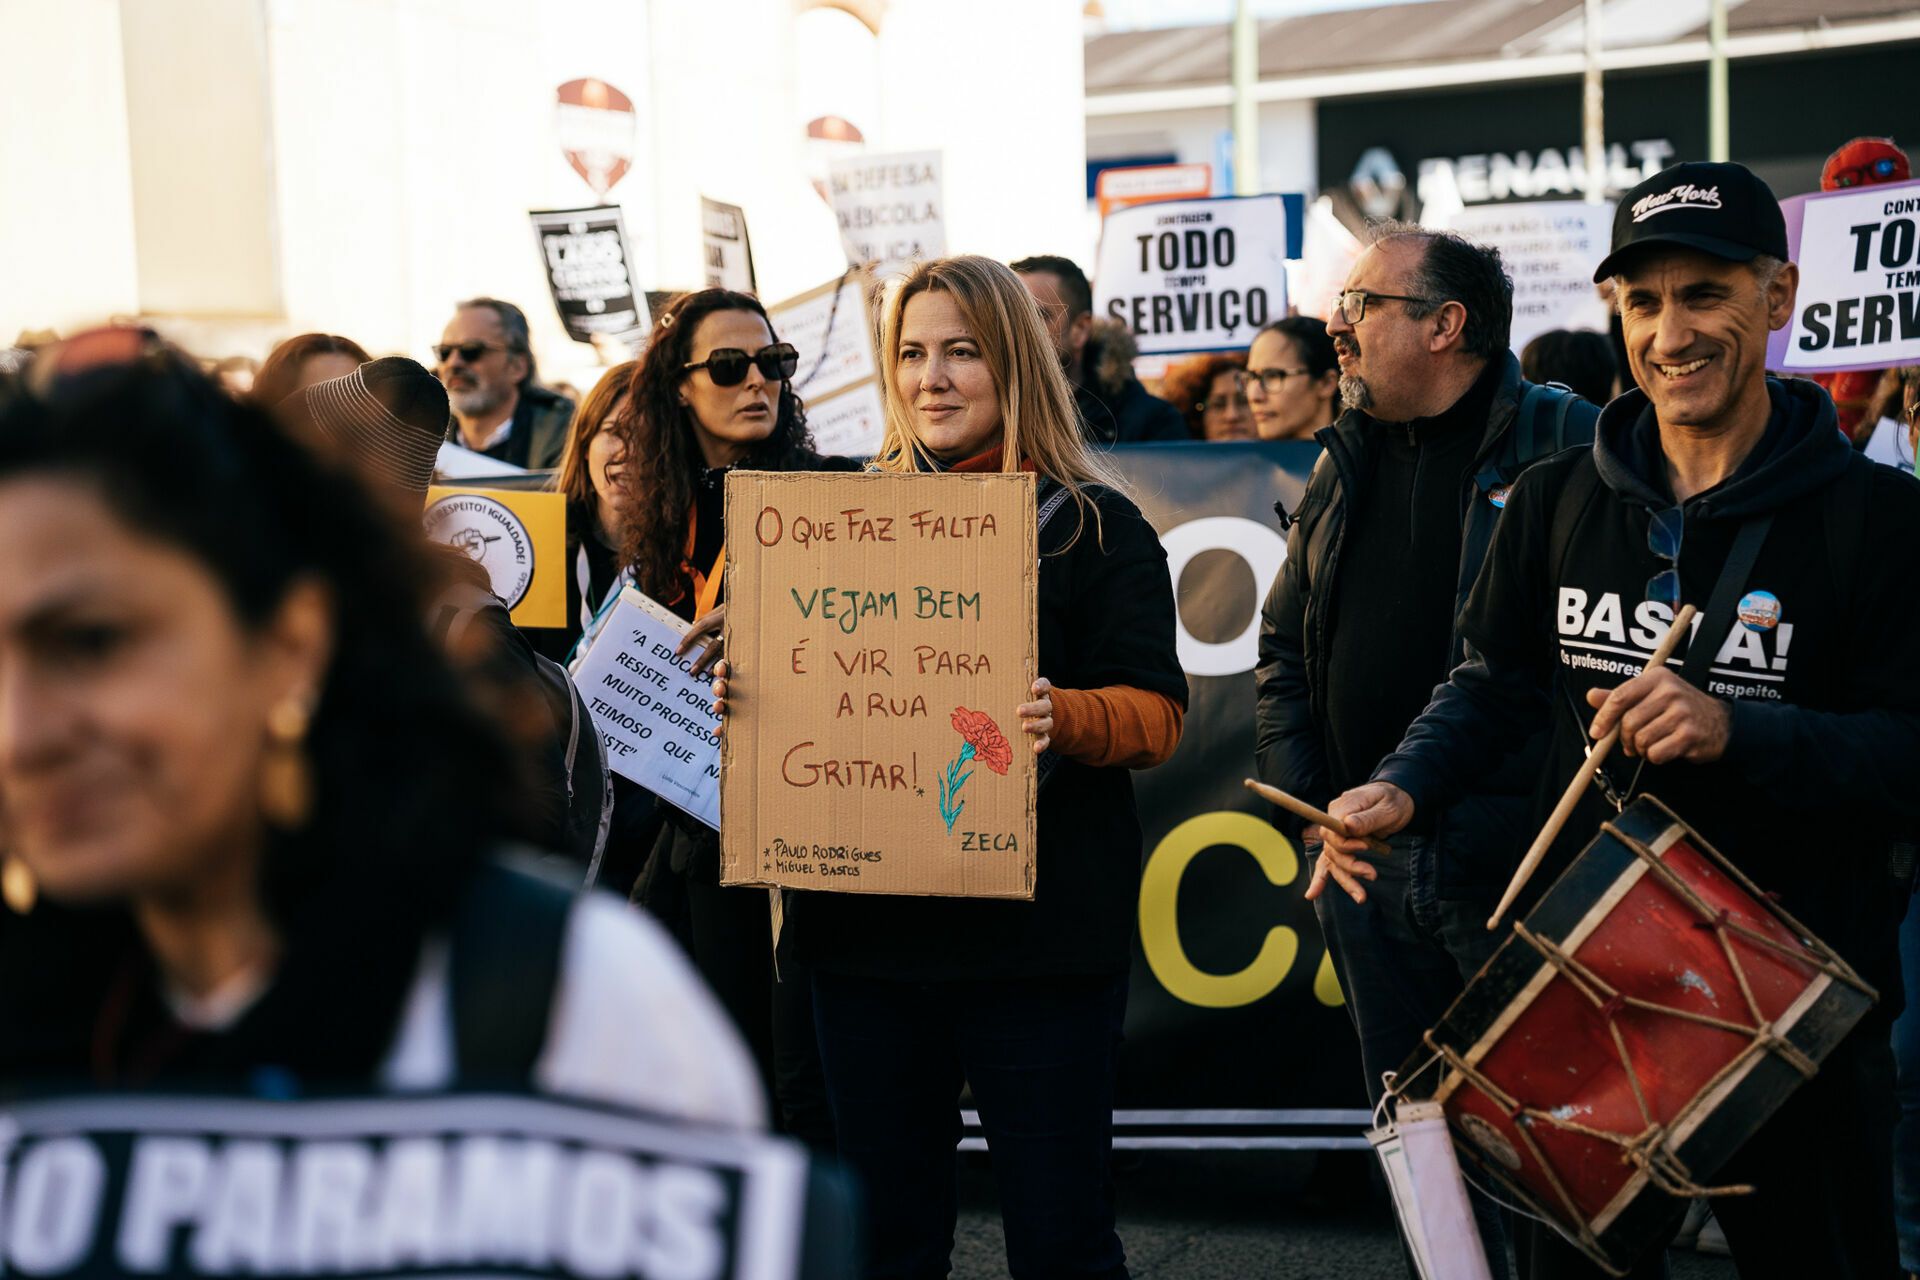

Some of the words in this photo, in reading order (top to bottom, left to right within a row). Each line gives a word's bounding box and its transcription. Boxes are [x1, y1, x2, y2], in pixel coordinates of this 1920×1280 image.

[856, 163, 935, 191] DEFESA
[856, 201, 939, 229] ESCOLA
[1631, 191, 1674, 217] New
[1671, 184, 1720, 203] York
[1137, 227, 1235, 273] TODO
[1850, 218, 1920, 273] TO
[1108, 287, 1268, 339] SERVIÇO
[487, 507, 527, 565] IGUALDADE!
[756, 506, 783, 546] O
[791, 516, 837, 549] QUE
[840, 508, 897, 542] FAZ
[909, 509, 997, 541] FALTA
[791, 587, 897, 634] VEJAM
[914, 586, 980, 621] BEM
[615, 651, 670, 692] RESISTE,
[791, 638, 810, 674] É
[914, 645, 991, 675] PARA
[1571, 651, 1643, 678] professores
[1708, 680, 1782, 700] respeito.
[602, 673, 651, 707] MUITO
[836, 692, 854, 719] A
[868, 692, 927, 717] RUA
[589, 697, 653, 739] TEIMOSO
[663, 741, 696, 764] QUE
[773, 838, 808, 859] PAULO
[961, 832, 1018, 851] ZECA
[819, 863, 860, 876] BASTOS
[114, 1136, 728, 1280] PARAMOS
